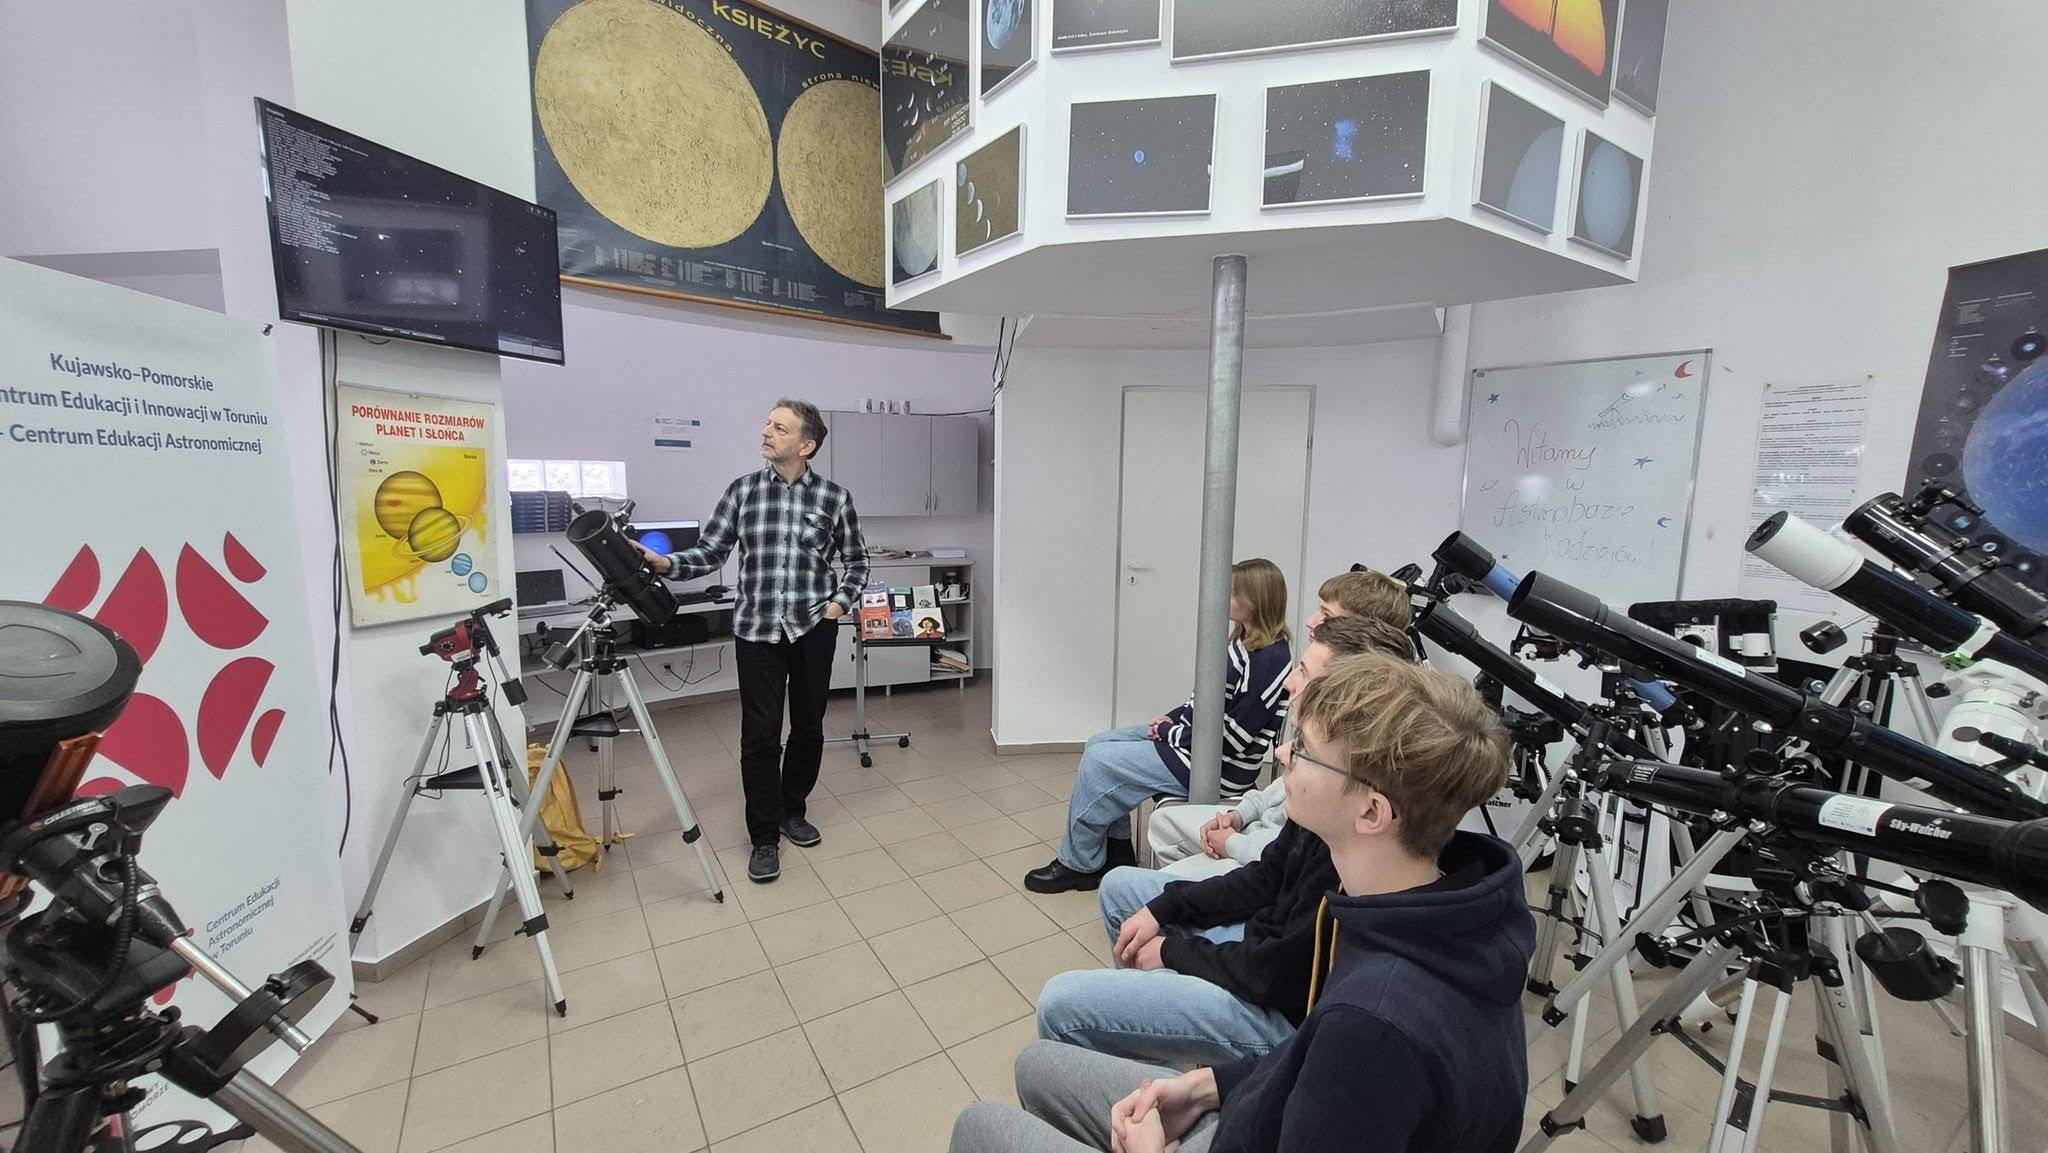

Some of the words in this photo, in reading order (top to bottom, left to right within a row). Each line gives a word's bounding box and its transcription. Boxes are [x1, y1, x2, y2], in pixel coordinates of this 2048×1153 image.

[712, 0, 825, 59] KSIĘŻYC
[801, 72, 842, 89] strona
[0, 386, 58, 407] ntrum
[61, 391, 131, 417] Edukacji
[135, 398, 140, 414] i
[143, 400, 208, 423] Innowacji
[210, 410, 221, 422] w
[223, 408, 268, 425] Toruniu
[352, 404, 421, 423] PORÓWNANIE
[424, 413, 485, 429] ROZMIARÓW
[9, 424, 94, 446] Centrum
[96, 429, 162, 452] Edukacji
[165, 433, 262, 455] Astronomicznej
[376, 423, 416, 438] PLANET
[426, 427, 465, 442] SŁOŃCA
[1504, 418, 1597, 470] Witamy
[1566, 478, 1585, 491] w
[44, 800, 99, 825] CELESTRON
[1487, 800, 1511, 808] atcher
[1889, 818, 1953, 840] Sky-Watcher
[206, 902, 245, 932] Centrum
[246, 877, 280, 906] Edukacji
[208, 895, 274, 947] Astronomicznej
[220, 927, 253, 953] Toruniu
[130, 1081, 169, 1120] OMORZE
